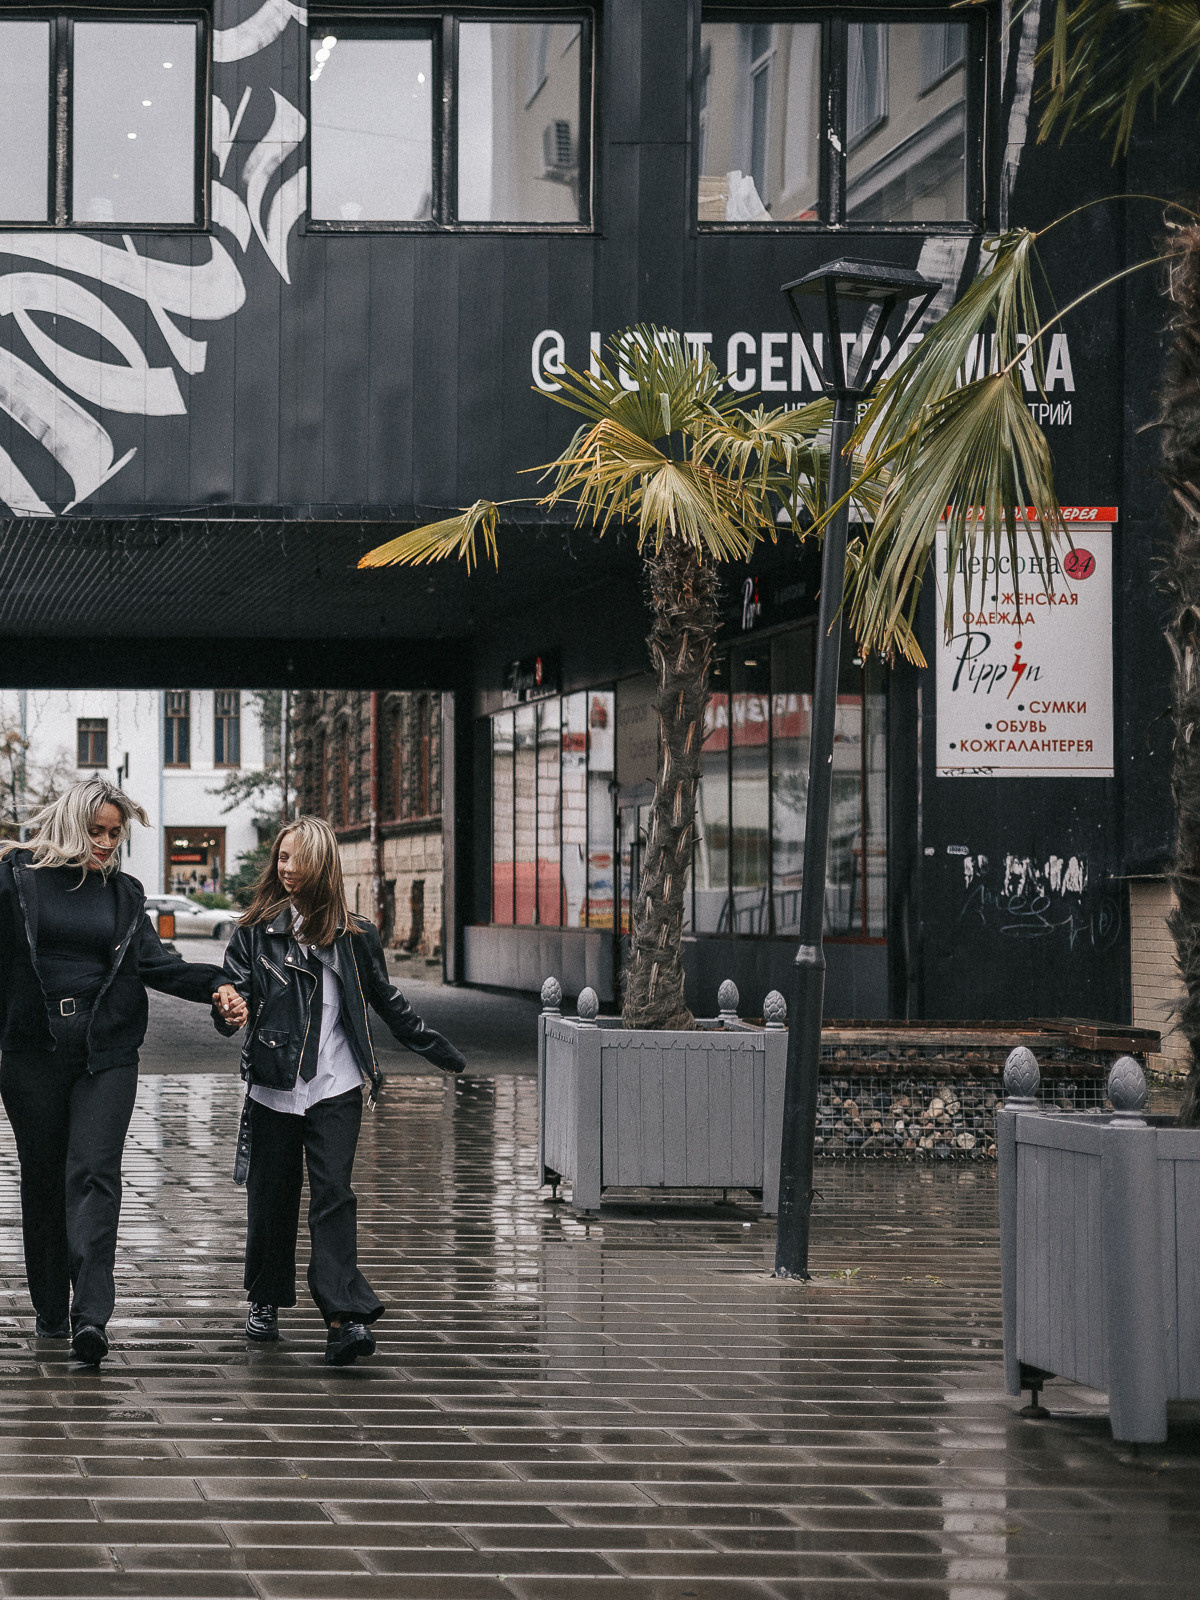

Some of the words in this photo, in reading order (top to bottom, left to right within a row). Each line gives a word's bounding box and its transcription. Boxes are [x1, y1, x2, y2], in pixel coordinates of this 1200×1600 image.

[1001, 593, 1078, 606] ЖЕНСКАЯ
[962, 612, 1036, 626] ОДЕЖДА
[946, 631, 1043, 700] Pippin
[1029, 701, 1087, 714] СУМКИ
[996, 720, 1047, 733] ОБУВЬ
[960, 738, 1094, 753] КОЖГАЛАНТЕРЕЯ
